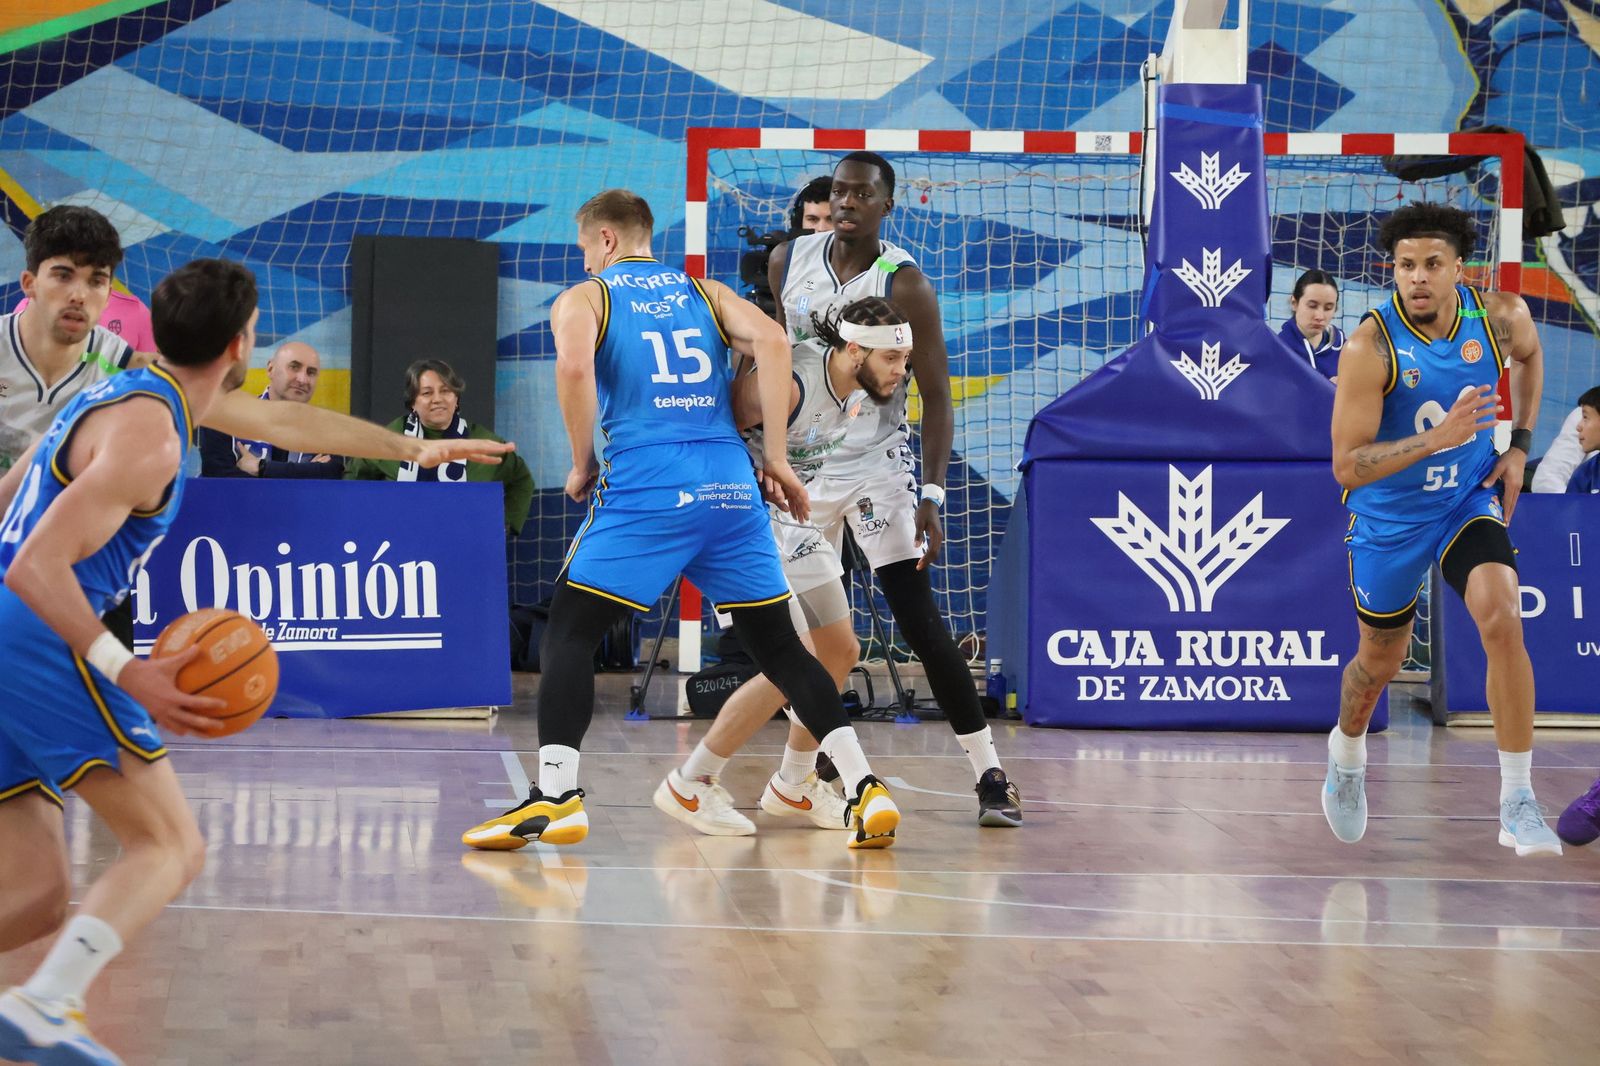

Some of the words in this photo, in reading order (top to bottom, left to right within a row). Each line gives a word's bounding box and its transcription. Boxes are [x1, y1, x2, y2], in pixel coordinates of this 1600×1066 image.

[630, 301, 671, 314] MGS
[640, 328, 713, 383] 15
[1422, 464, 1459, 491] 51
[131, 567, 158, 625] a
[180, 536, 441, 622] Opinión
[276, 623, 338, 642] Zamora
[1046, 629, 1164, 669] CAJA
[1175, 629, 1340, 668] RURAL
[1077, 675, 1126, 702] DE
[1139, 675, 1292, 702] ZAMORA
